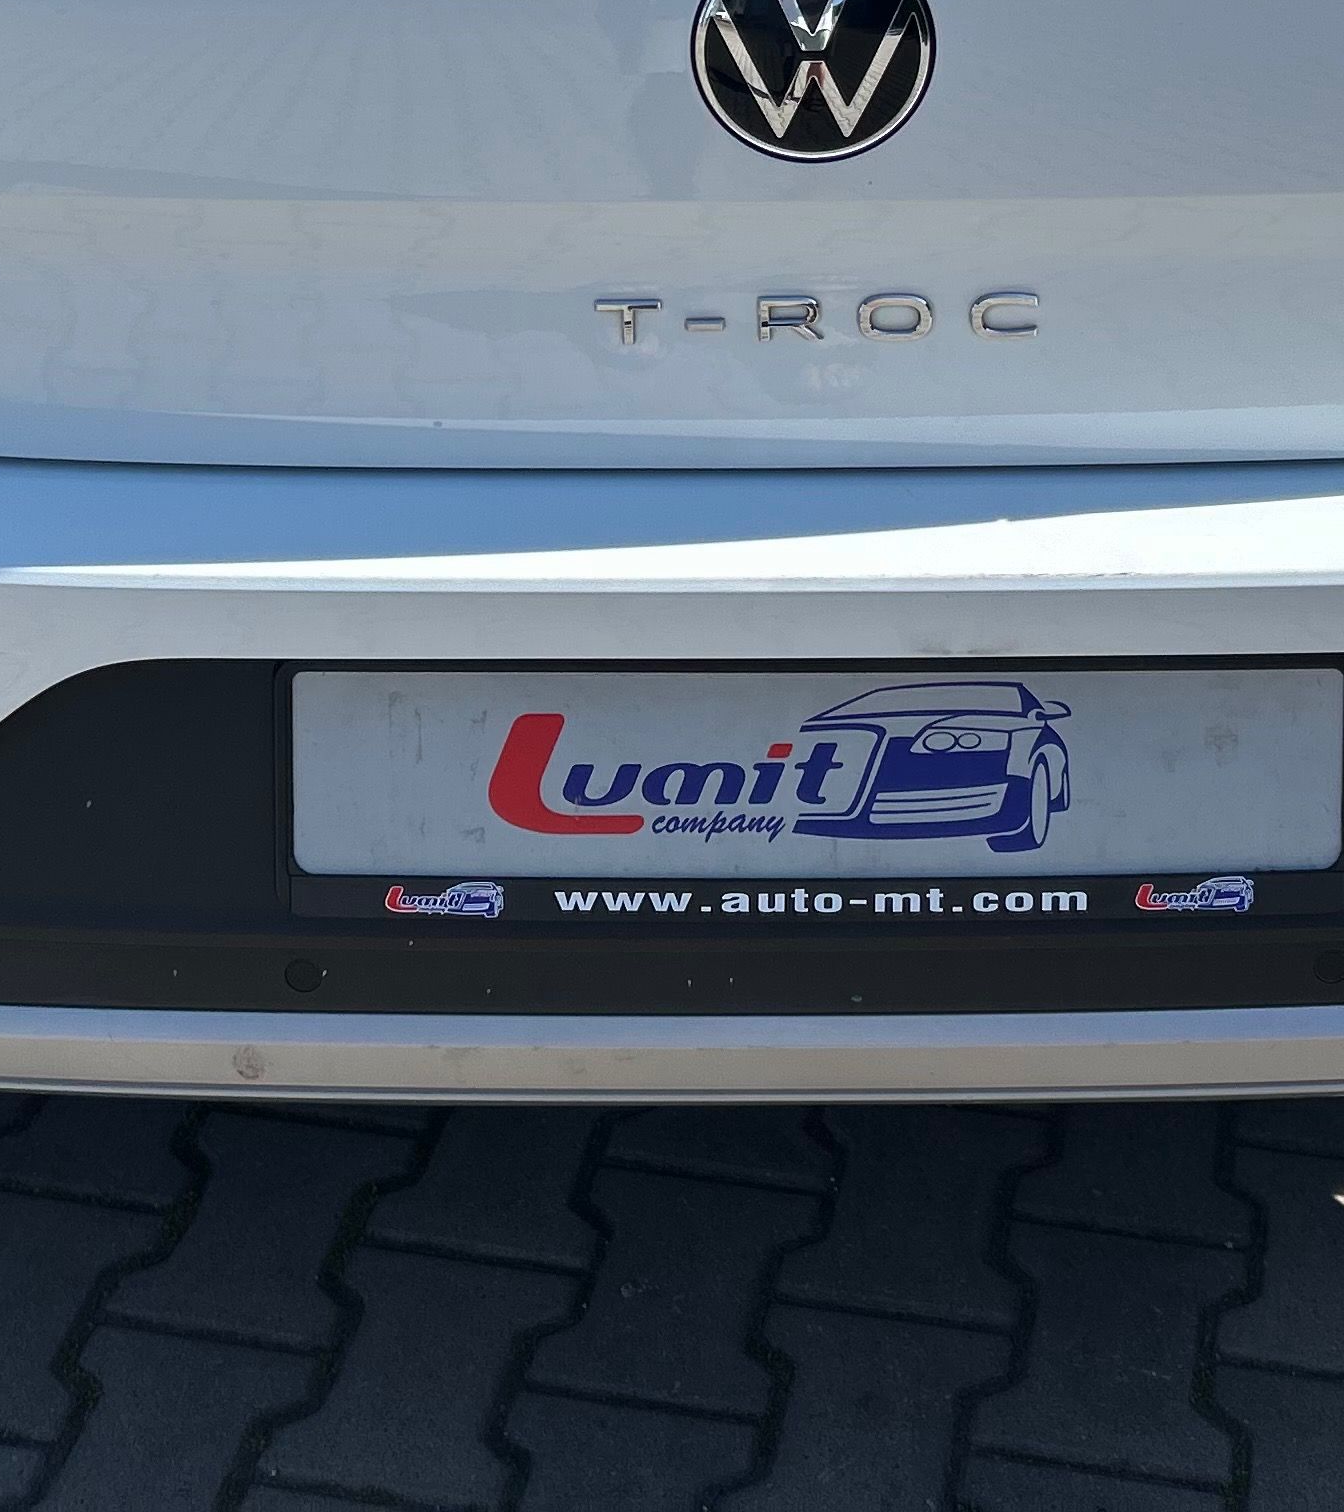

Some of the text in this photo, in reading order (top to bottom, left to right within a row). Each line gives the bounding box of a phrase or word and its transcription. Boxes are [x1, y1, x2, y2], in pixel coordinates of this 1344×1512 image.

[594, 291, 1040, 345] T-ROC
[488, 713, 844, 834] Lumit
[651, 811, 786, 843] company
[385, 886, 460, 912] Lumit
[554, 887, 1089, 914] www.auto-mt.com
[1135, 883, 1210, 910] Lumit
